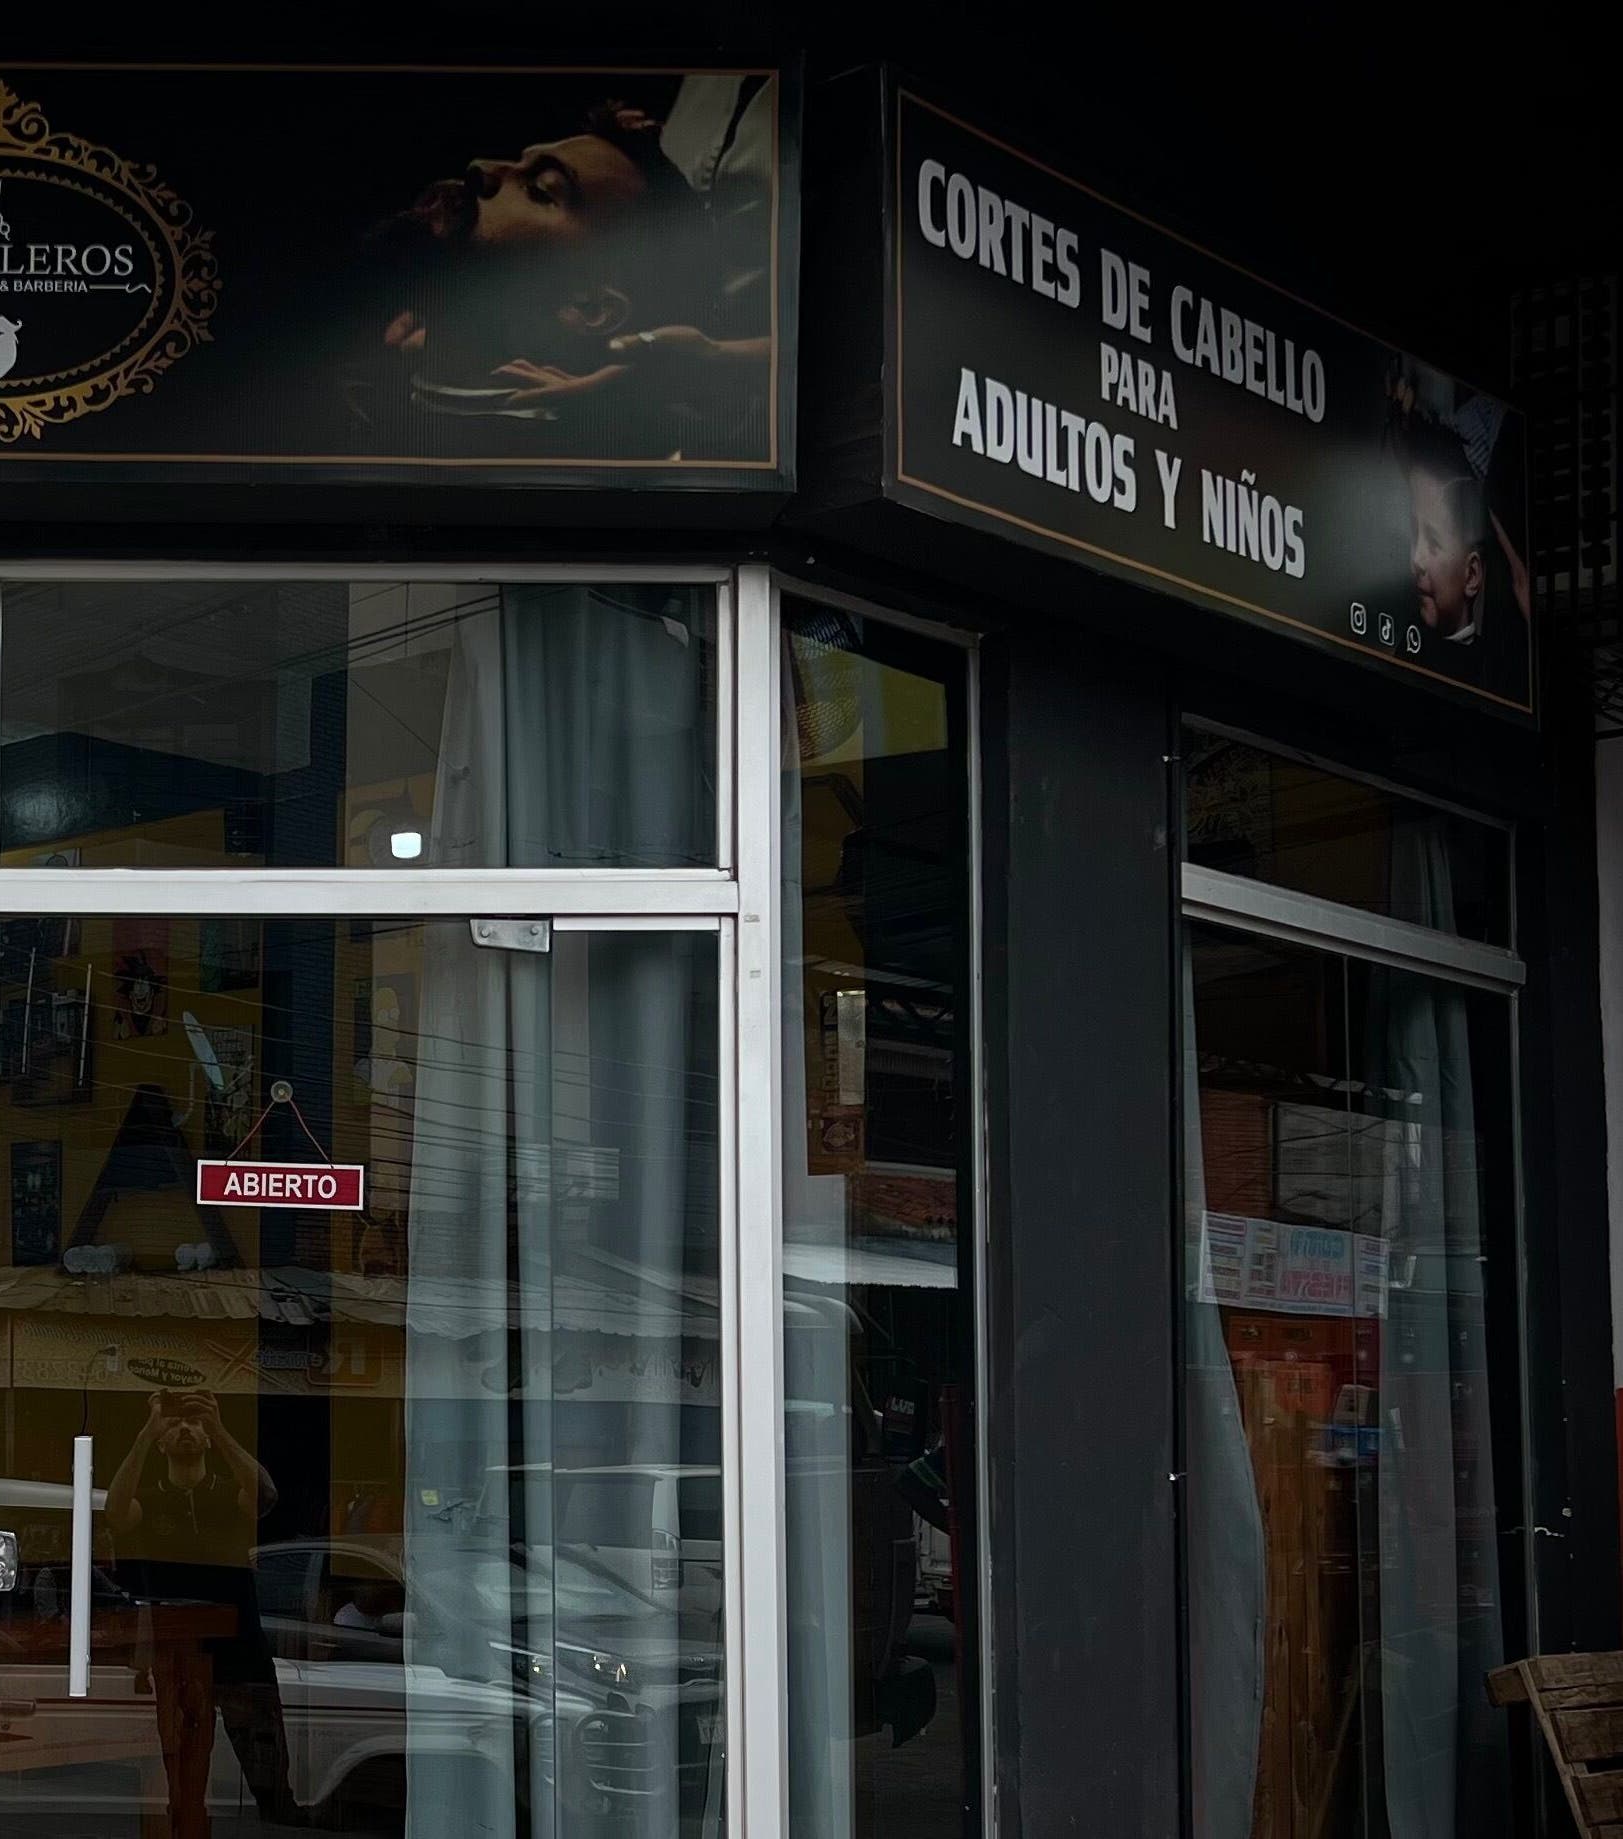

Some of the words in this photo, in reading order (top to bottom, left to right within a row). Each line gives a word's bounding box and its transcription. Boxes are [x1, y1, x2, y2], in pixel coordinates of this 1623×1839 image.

[0, 278, 9, 293] &
[13, 278, 88, 293] BARBERIA
[917, 158, 1080, 309] CORTES
[1100, 247, 1153, 345] DE
[1170, 285, 1326, 424] CABELLO
[1099, 341, 1178, 430] PARA
[952, 367, 1138, 513] ADULTOS
[1155, 449, 1183, 530] Y
[1201, 467, 1306, 579] NIÑOS
[223, 1172, 337, 1199] ABIERTO
